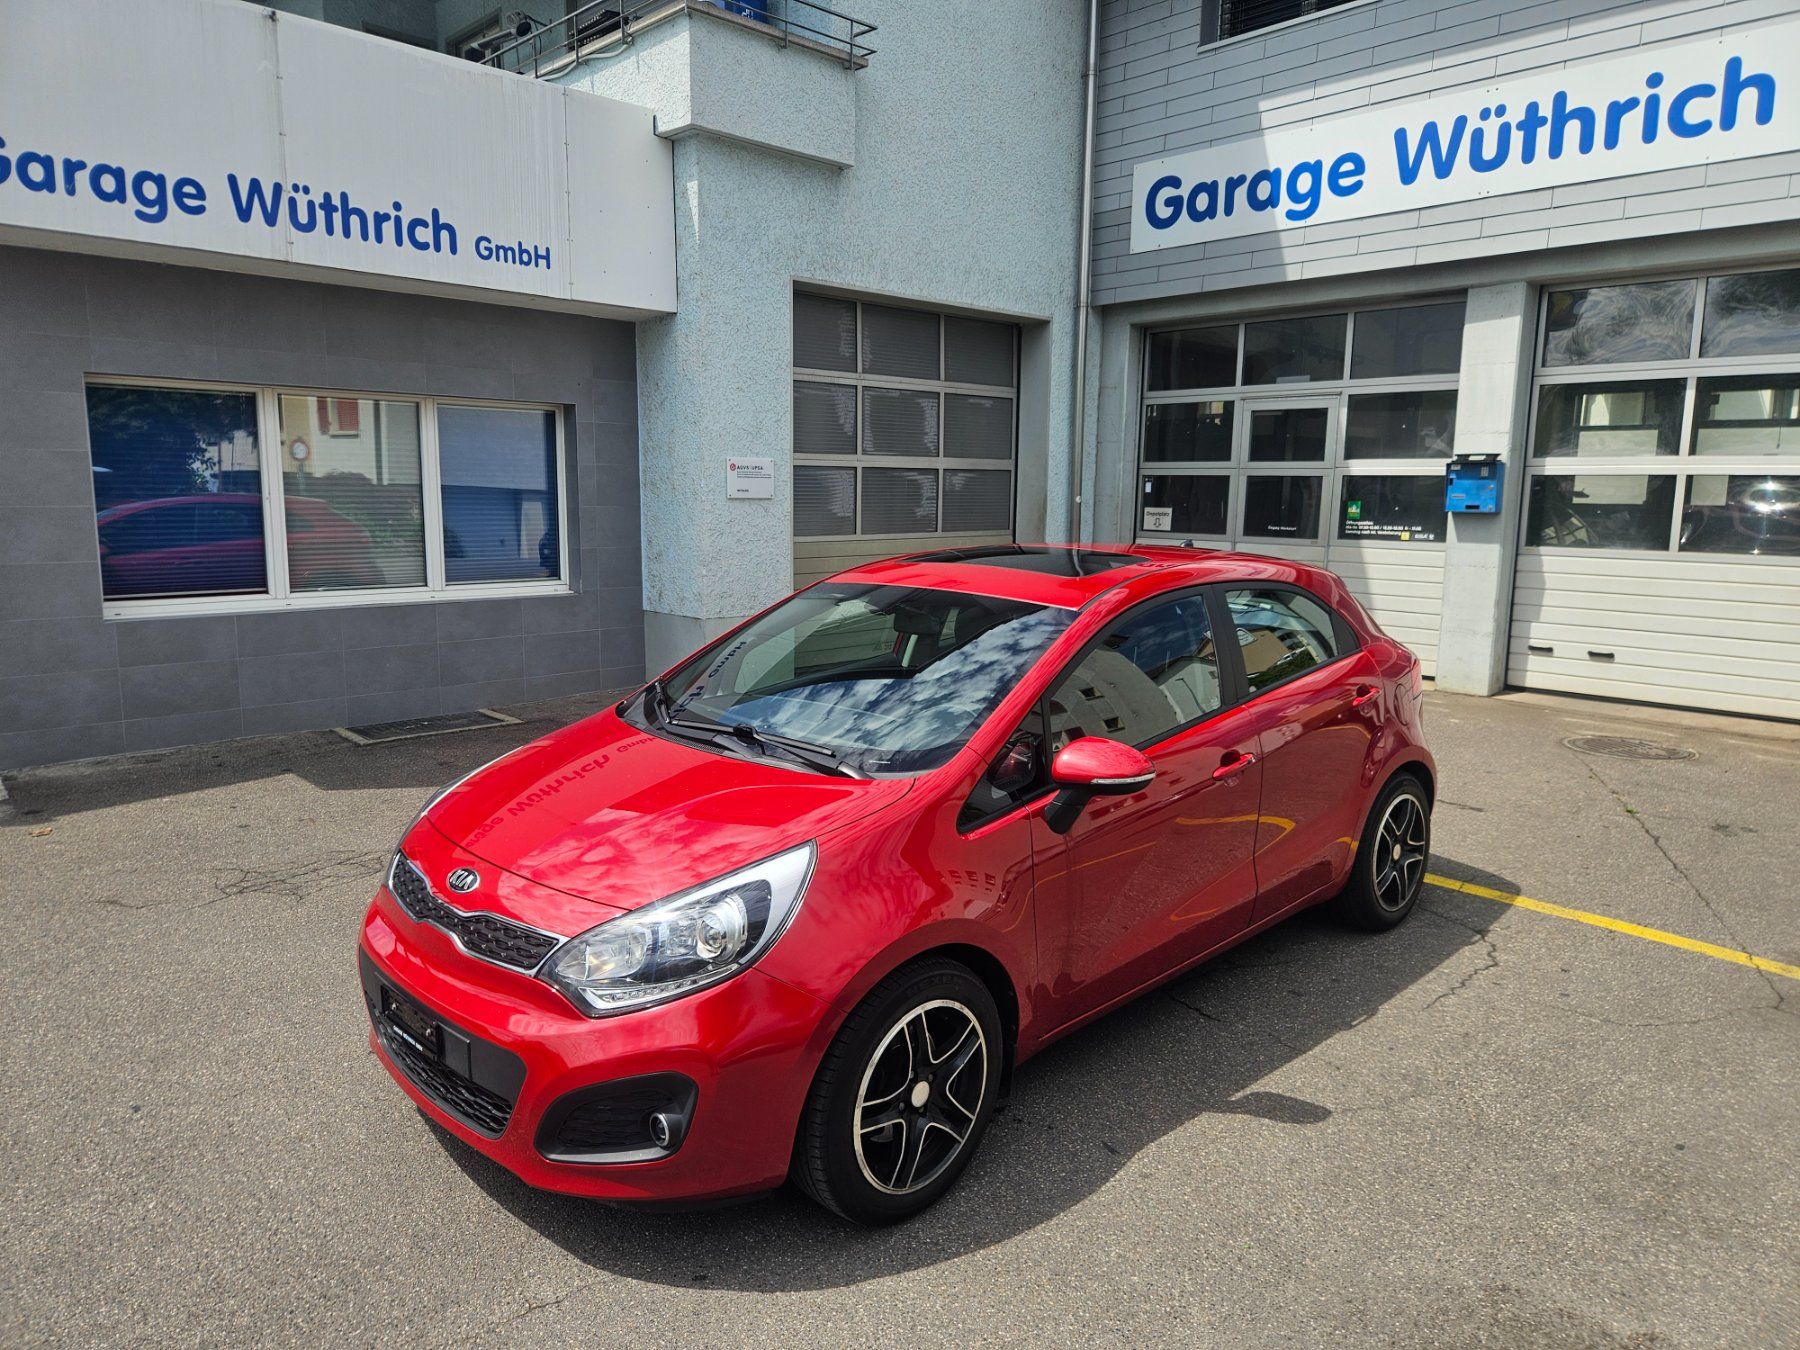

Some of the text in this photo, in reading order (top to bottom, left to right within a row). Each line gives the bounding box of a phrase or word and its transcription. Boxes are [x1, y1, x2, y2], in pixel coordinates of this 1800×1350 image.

[0, 136, 551, 270] arage Wüthrich GmbH
[1145, 55, 1777, 230] Garage Wüthrich
[449, 869, 474, 890] KIA
